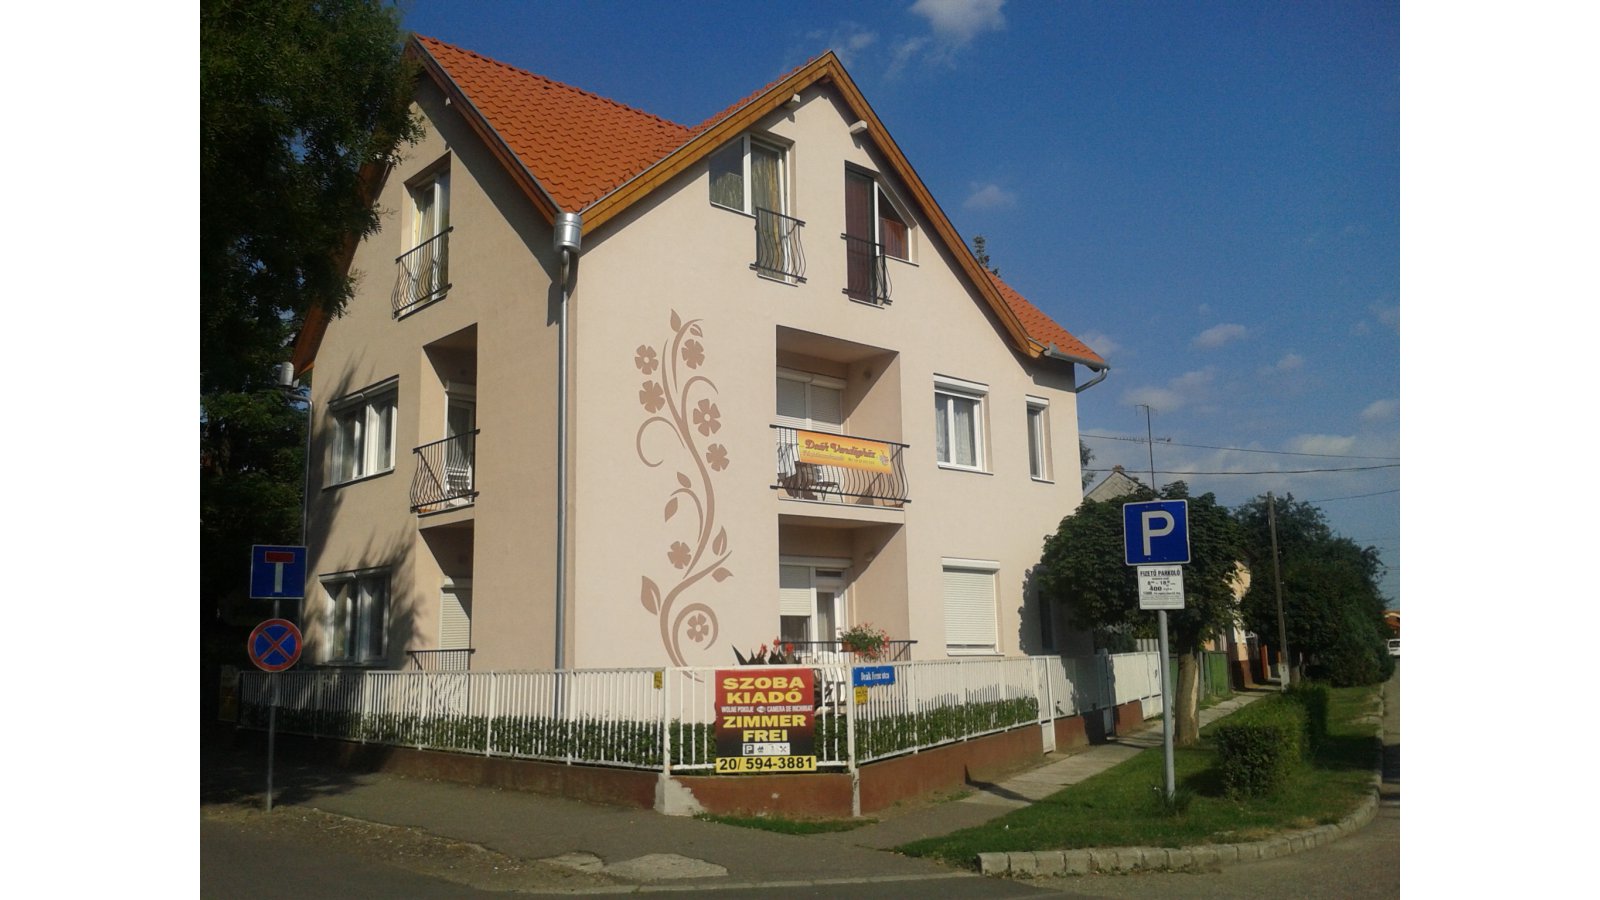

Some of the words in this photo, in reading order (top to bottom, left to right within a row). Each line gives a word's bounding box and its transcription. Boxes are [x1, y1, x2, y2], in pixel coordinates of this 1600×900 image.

[1141, 510, 1175, 556] P
[1140, 569, 1156, 577] FIZETŐ
[723, 677, 805, 690] SZOBA
[726, 689, 802, 704] KIADÓ
[722, 714, 807, 728] ZIMMER
[742, 729, 788, 742] FREI
[719, 758, 741, 771] 20/
[745, 757, 813, 770] 594-3881
